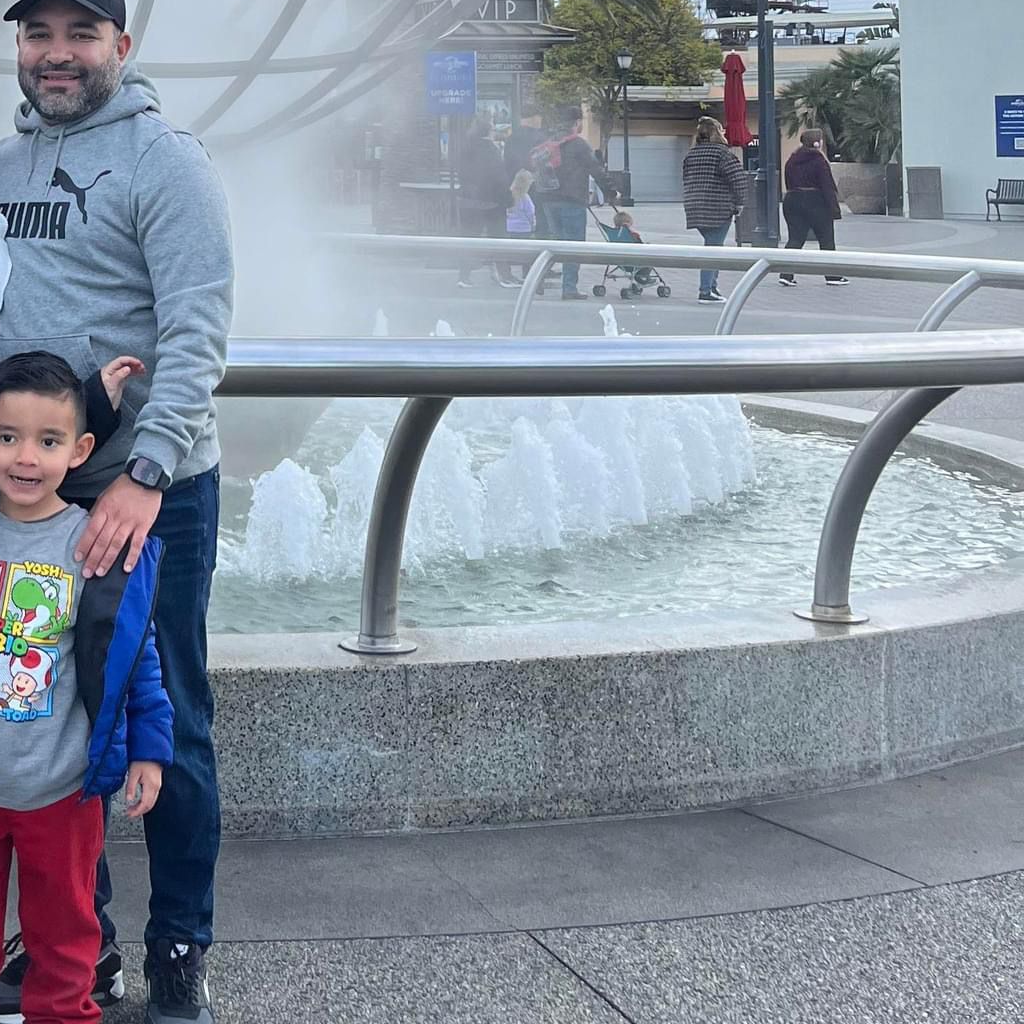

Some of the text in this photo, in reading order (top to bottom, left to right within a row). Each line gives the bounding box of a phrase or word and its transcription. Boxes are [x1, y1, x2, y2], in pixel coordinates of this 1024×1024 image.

[478, 0, 516, 20] VIP
[23, 560, 64, 580] YOSHI
[2, 708, 38, 723] TOAD
